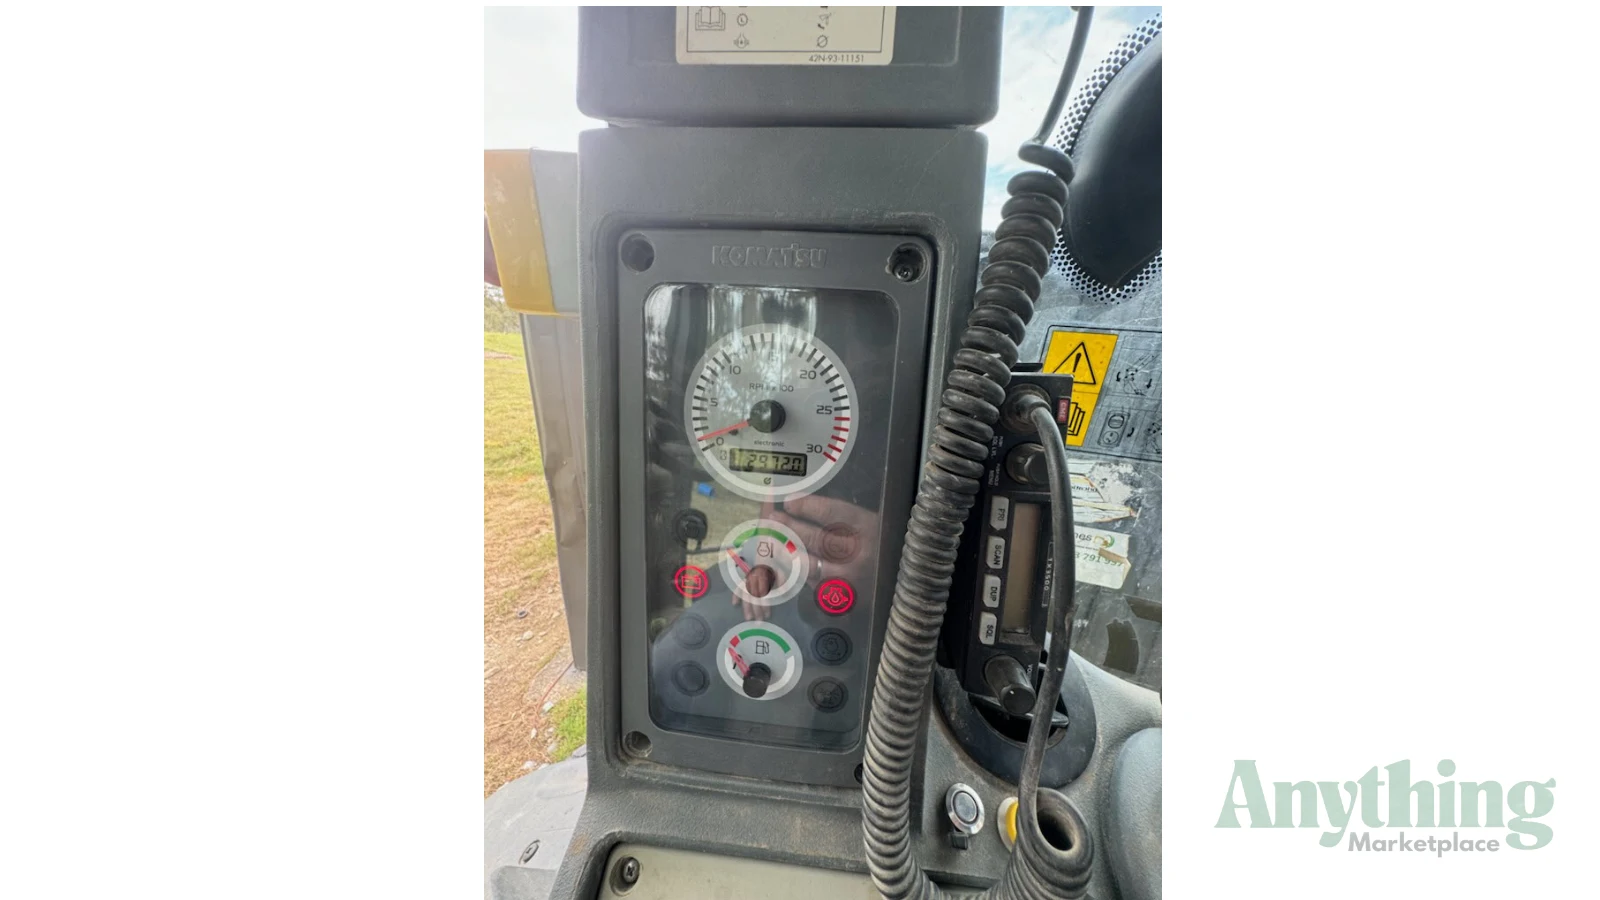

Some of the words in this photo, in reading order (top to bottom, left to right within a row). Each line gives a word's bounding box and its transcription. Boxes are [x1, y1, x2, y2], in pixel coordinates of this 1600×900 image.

[808, 54, 864, 63] 42N-93-11151
[711, 243, 827, 268] KOMATSU
[729, 365, 742, 375] 10
[799, 370, 817, 380] 20
[710, 397, 718, 407] 5
[816, 405, 833, 415] 25
[716, 436, 725, 446] 0
[753, 439, 785, 447] electronic
[806, 444, 823, 454] 30
[998, 508, 1006, 522] PRI
[993, 545, 1003, 566] SCAN
[985, 624, 994, 639] SQL
